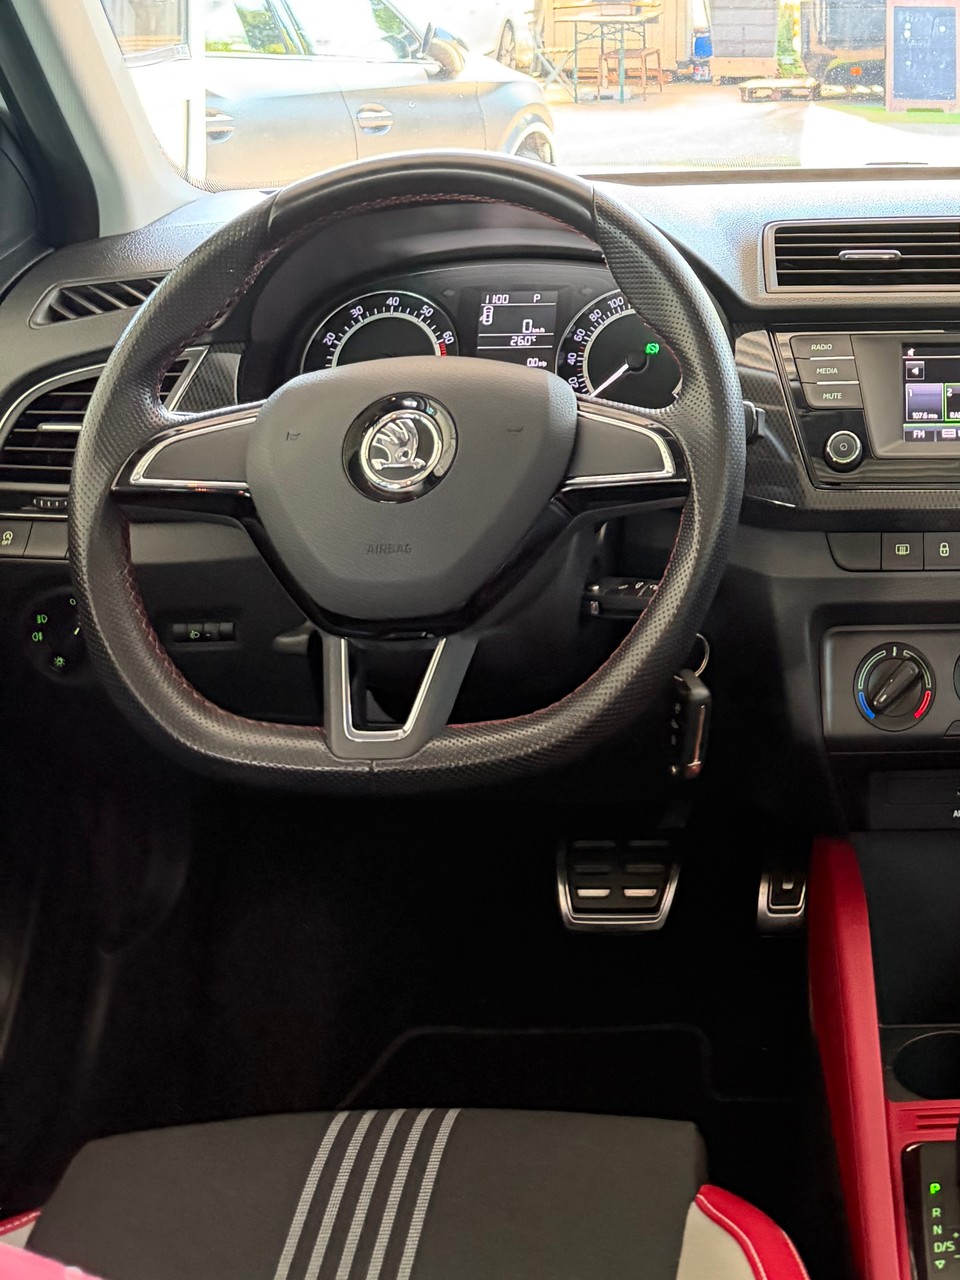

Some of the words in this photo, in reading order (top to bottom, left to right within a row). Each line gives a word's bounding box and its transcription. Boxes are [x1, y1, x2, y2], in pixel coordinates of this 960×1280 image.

[386, 296, 400, 306] 40
[485, 294, 509, 304] 11:00
[533, 293, 541, 303] P
[607, 296, 625, 309] 100
[349, 305, 364, 318] 30
[420, 304, 434, 317] 50
[588, 308, 602, 322] 80
[522, 318, 533, 334] 0
[322, 332, 336, 346] 20
[442, 330, 455, 345] 60
[573, 328, 586, 342] 60
[810, 343, 833, 351] RADIO
[567, 352, 577, 366] 40
[822, 392, 843, 400] MUTE
[946, 387, 953, 397] 2
[913, 429, 926, 439] FM
[929, 1182, 941, 1195] P
[932, 1207, 942, 1218] R
[932, 1224, 943, 1235] N
[933, 1240, 956, 1253] D/S
